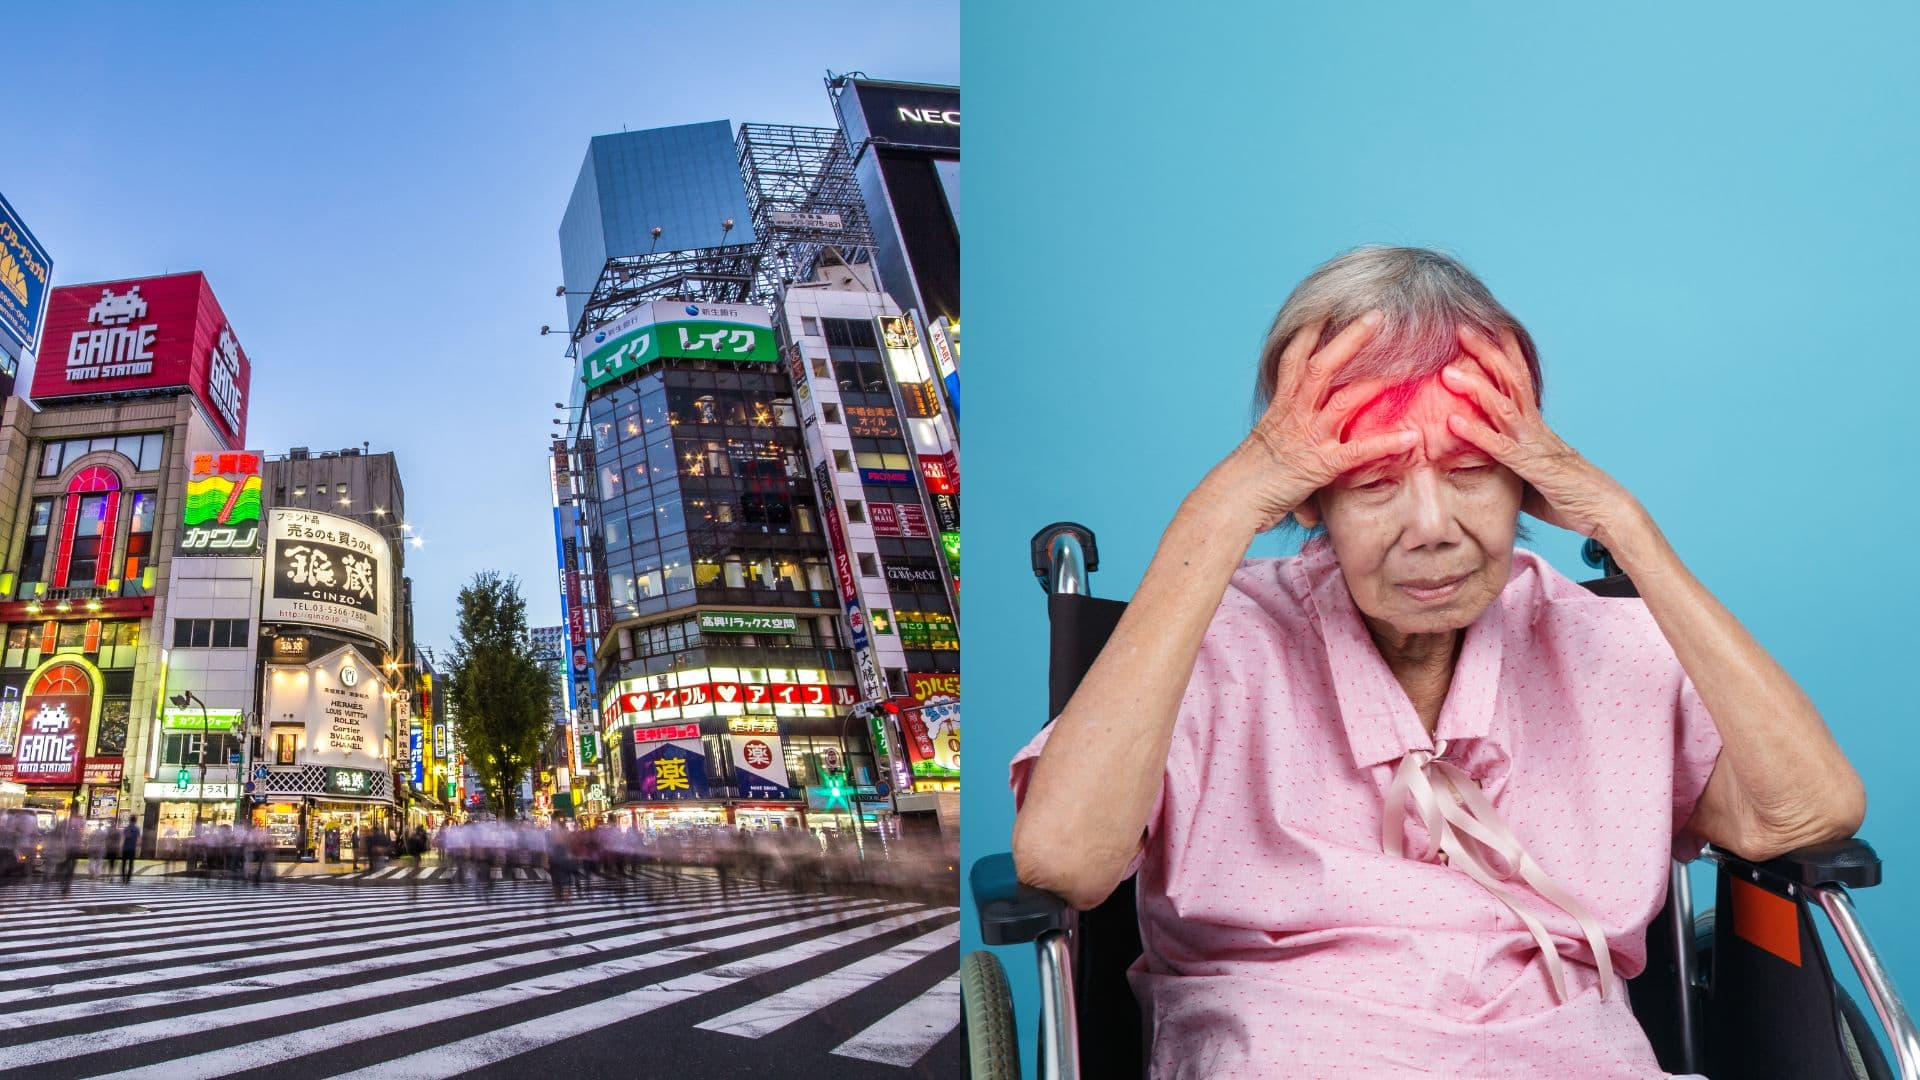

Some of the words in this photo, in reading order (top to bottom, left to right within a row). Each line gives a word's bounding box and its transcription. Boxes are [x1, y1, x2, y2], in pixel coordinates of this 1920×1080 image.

[702, 308, 738, 318] 新生銀行
[66, 324, 158, 367] GAME
[678, 327, 756, 353] レイク
[590, 332, 650, 381] レイク
[65, 368, 99, 381] TAITO
[101, 361, 153, 378] STATION
[210, 347, 242, 426] GAME
[859, 417, 887, 427] オイル
[181, 527, 259, 548] カワノ
[653, 686, 706, 709] アイフル
[749, 685, 854, 705] アイフル
[325, 708, 342, 716] LOUIS
[344, 710, 368, 719] VUITTON
[335, 716, 360, 726] ROLEX
[329, 732, 364, 742] BVLGARI
[333, 725, 361, 734] Cartier
[18, 734, 76, 762] GAME
[330, 740, 363, 750] CHANEL
[745, 743, 770, 765] 薬
[17, 763, 38, 773] TAITO
[39, 763, 72, 773] STATION
[654, 757, 690, 791] 薬
